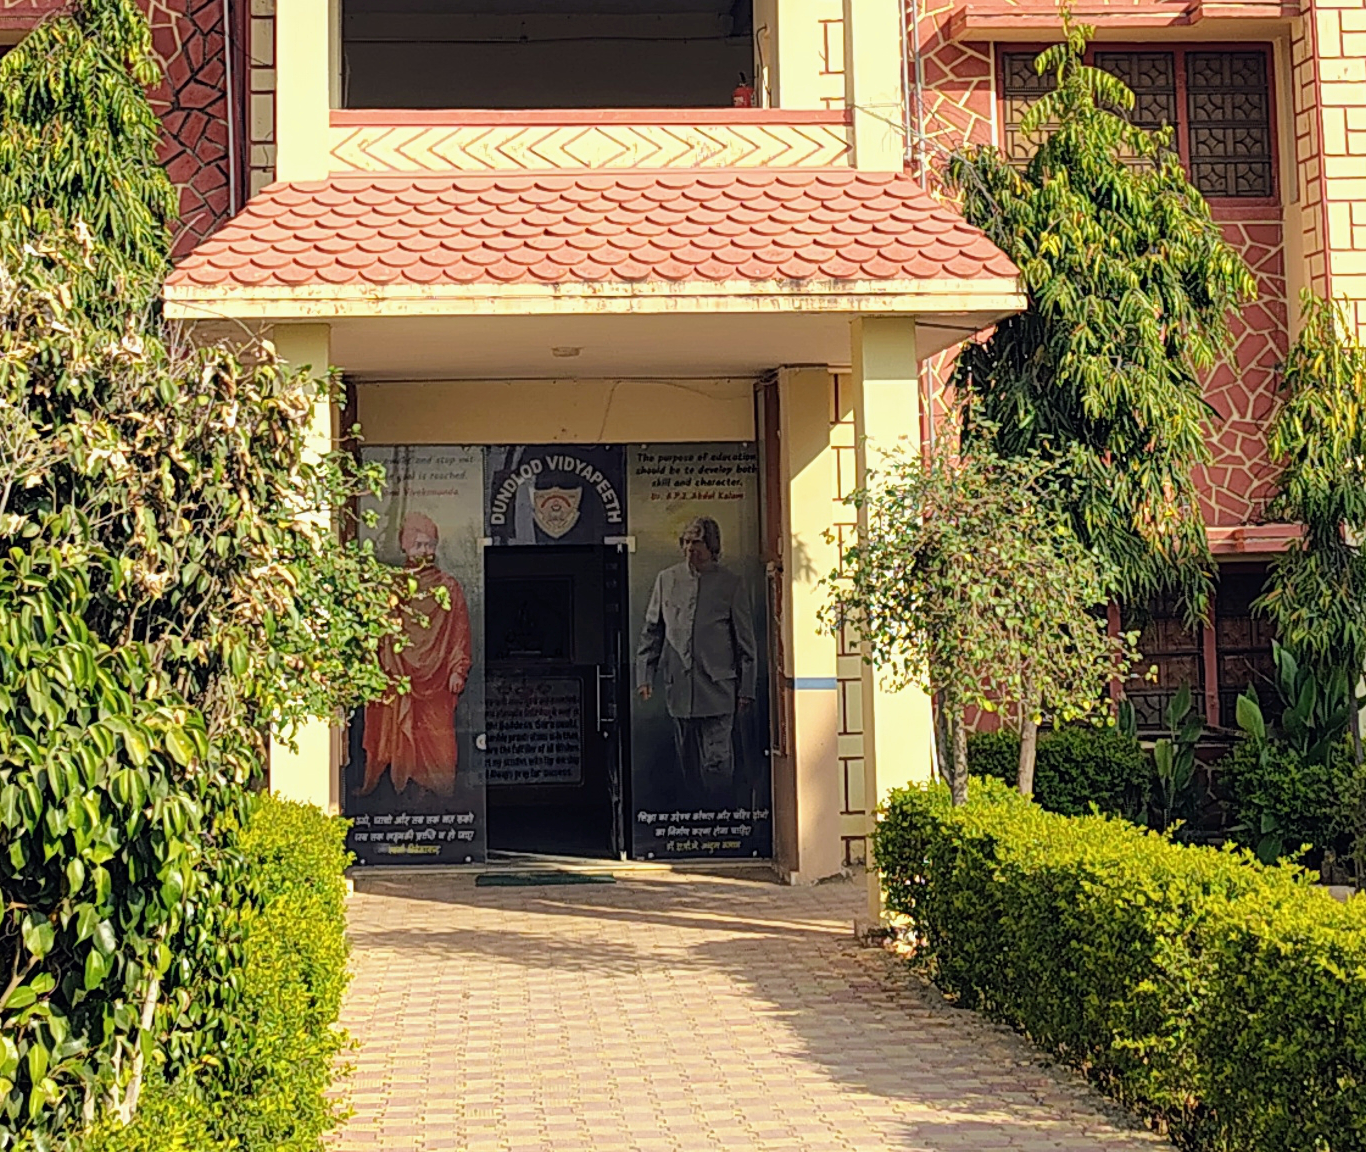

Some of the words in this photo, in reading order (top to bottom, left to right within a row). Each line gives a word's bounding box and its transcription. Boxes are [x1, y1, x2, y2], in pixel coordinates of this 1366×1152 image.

[637, 453, 654, 462] The
[658, 454, 694, 464] purpose
[698, 453, 708, 461] of
[711, 453, 756, 462] education
[636, 465, 665, 474] should
[698, 465, 733, 475] develop
[674, 478, 692, 486] and
[490, 459, 543, 525] DUNDLOD
[545, 455, 622, 523] VIDYAPEETH
